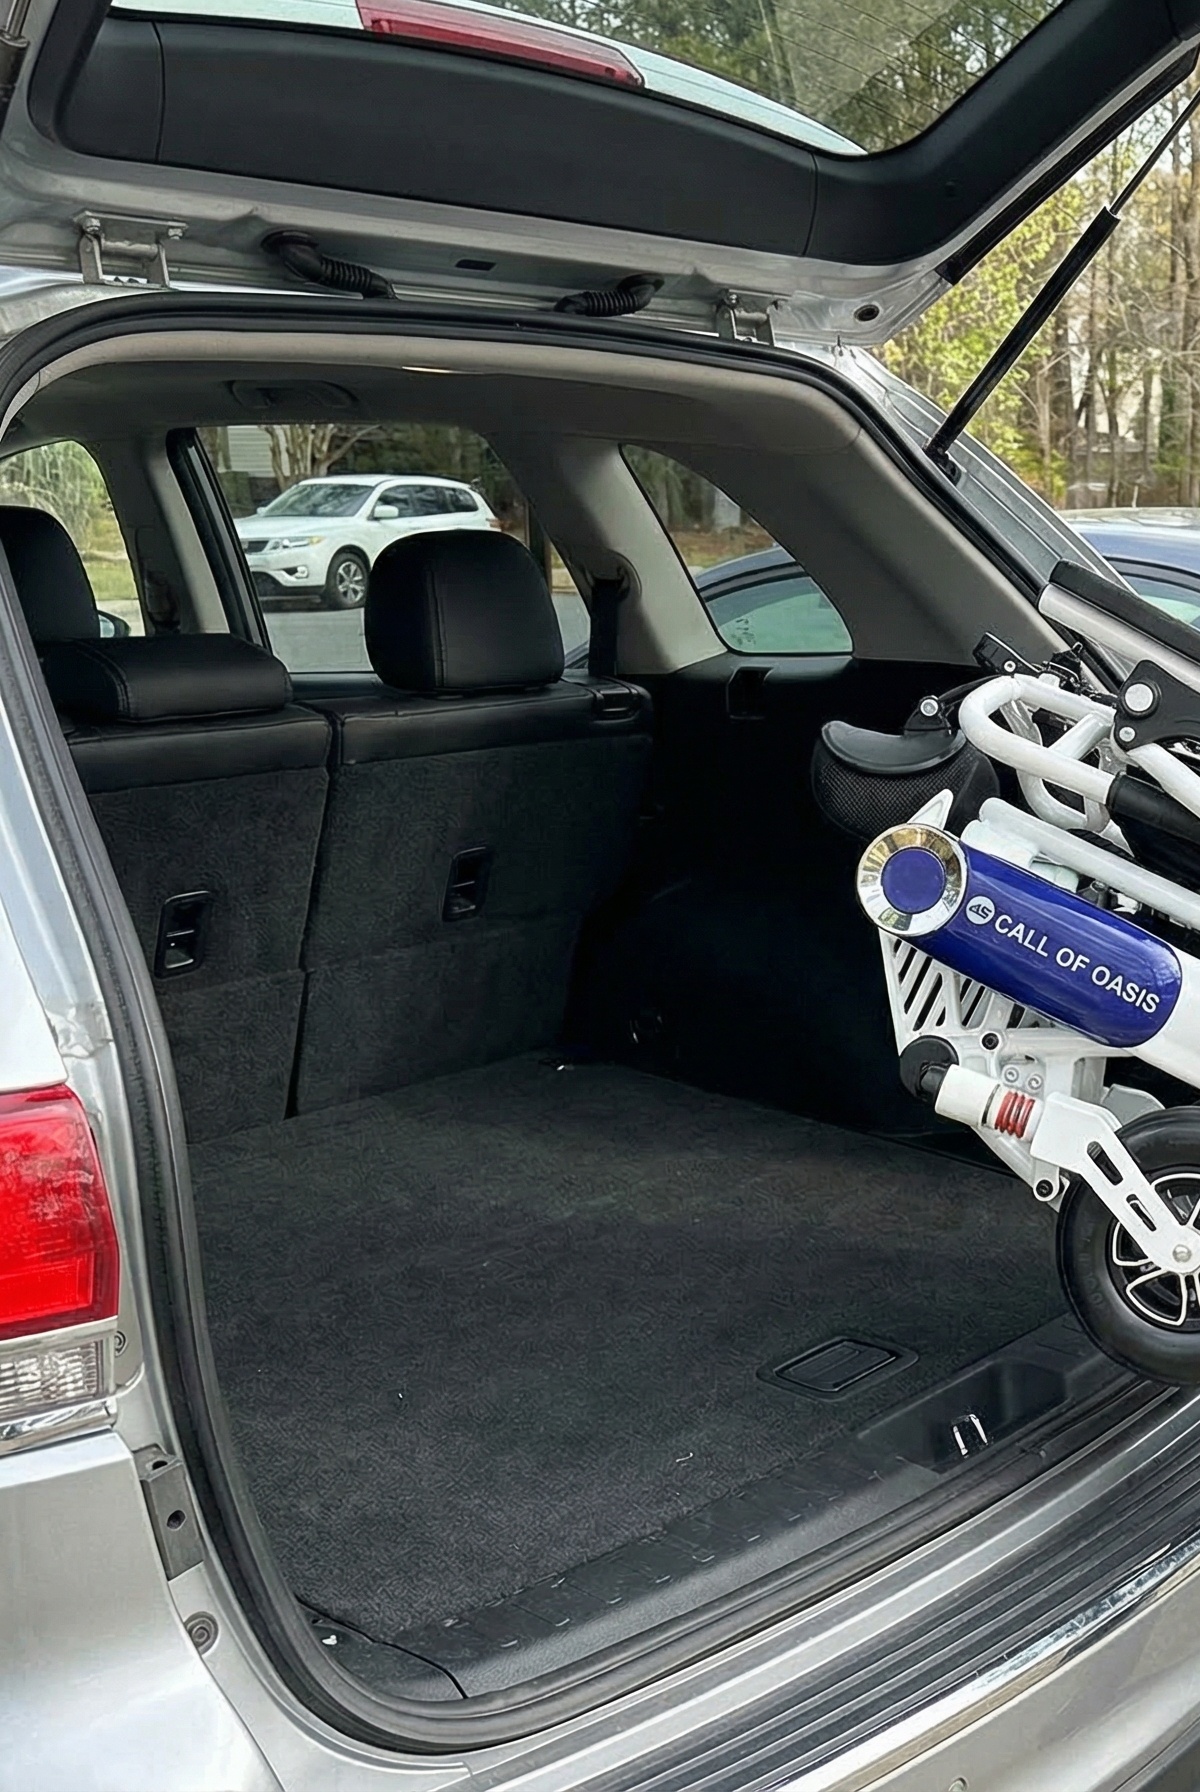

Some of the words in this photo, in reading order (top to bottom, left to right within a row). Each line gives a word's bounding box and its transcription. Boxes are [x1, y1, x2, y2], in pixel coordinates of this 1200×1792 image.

[995, 914, 1048, 957] CALL
[1056, 947, 1090, 972] OF
[1091, 965, 1160, 1013] OASIS
